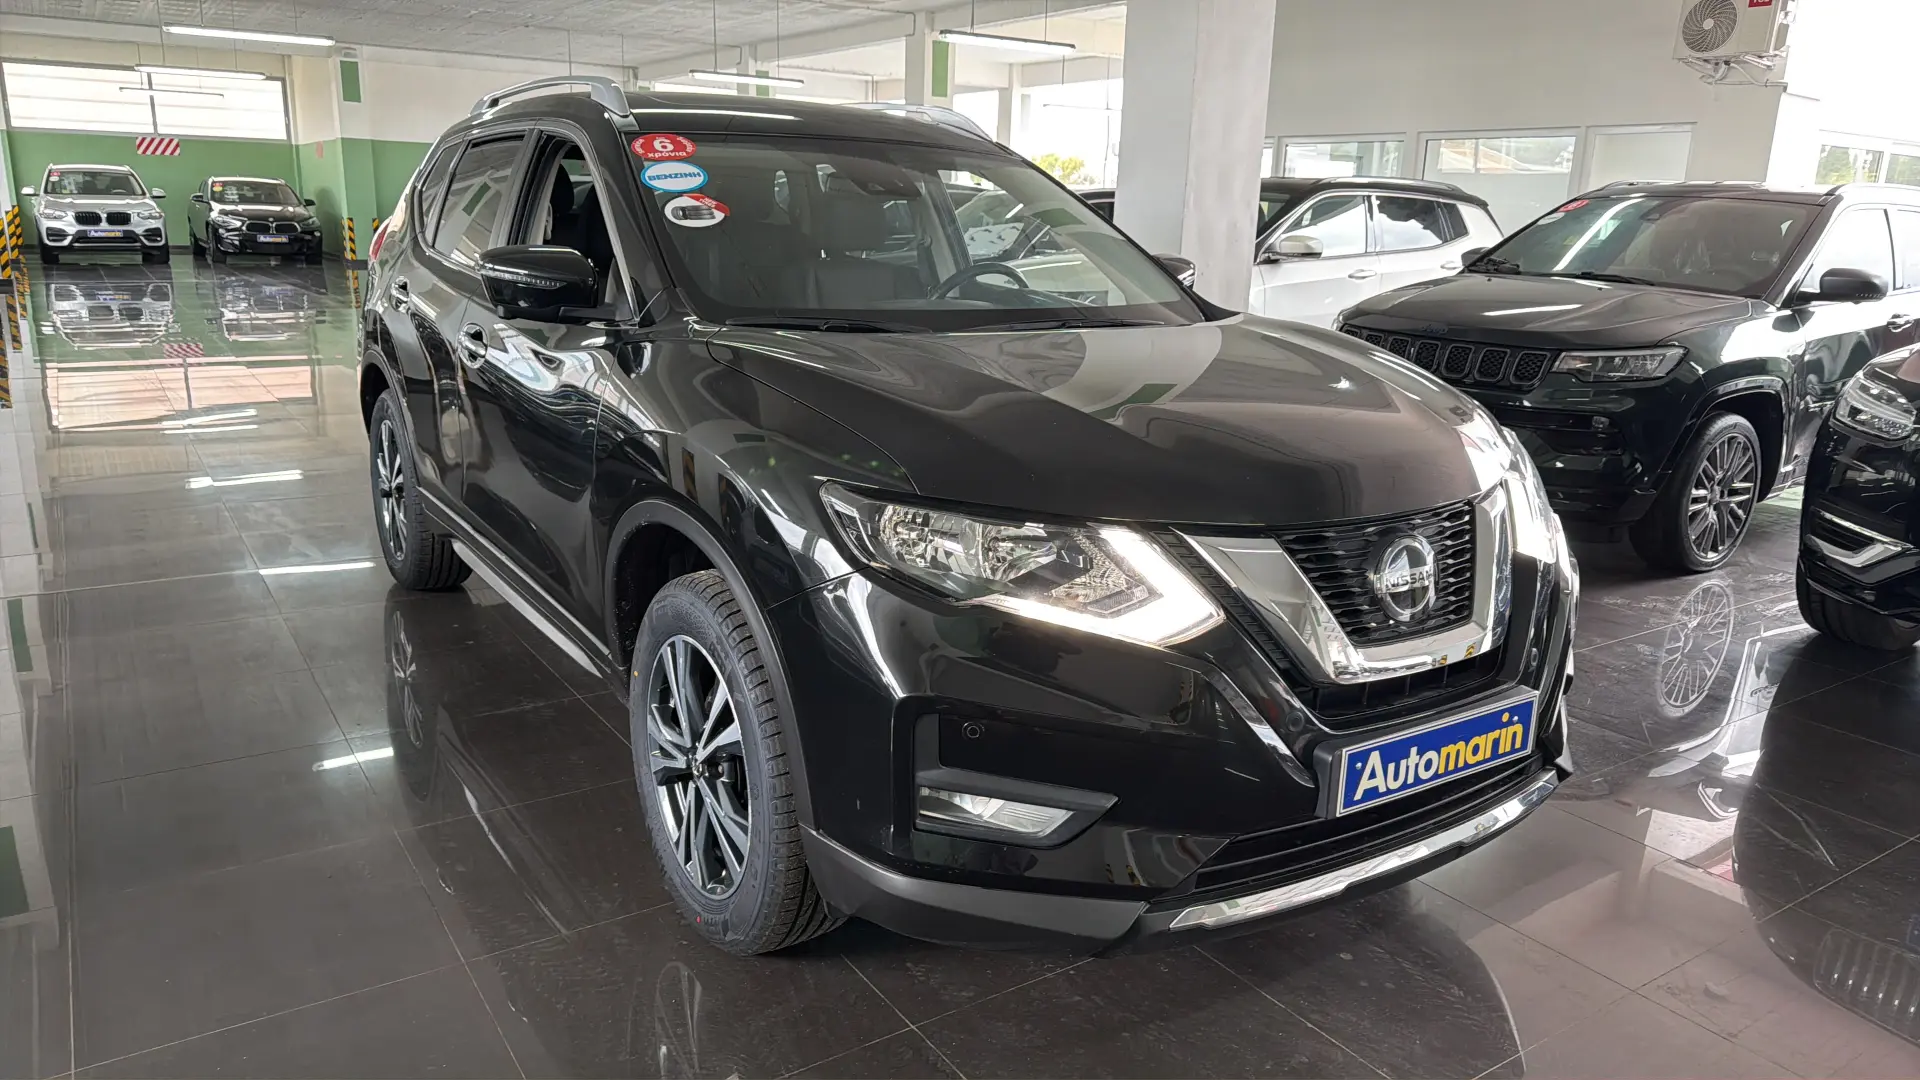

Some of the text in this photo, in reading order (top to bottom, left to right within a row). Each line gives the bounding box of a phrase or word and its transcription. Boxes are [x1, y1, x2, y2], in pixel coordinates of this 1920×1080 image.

[653, 138, 674, 152] 6
[1385, 567, 1433, 588] NISSAN
[1353, 711, 1524, 801] Automarin
